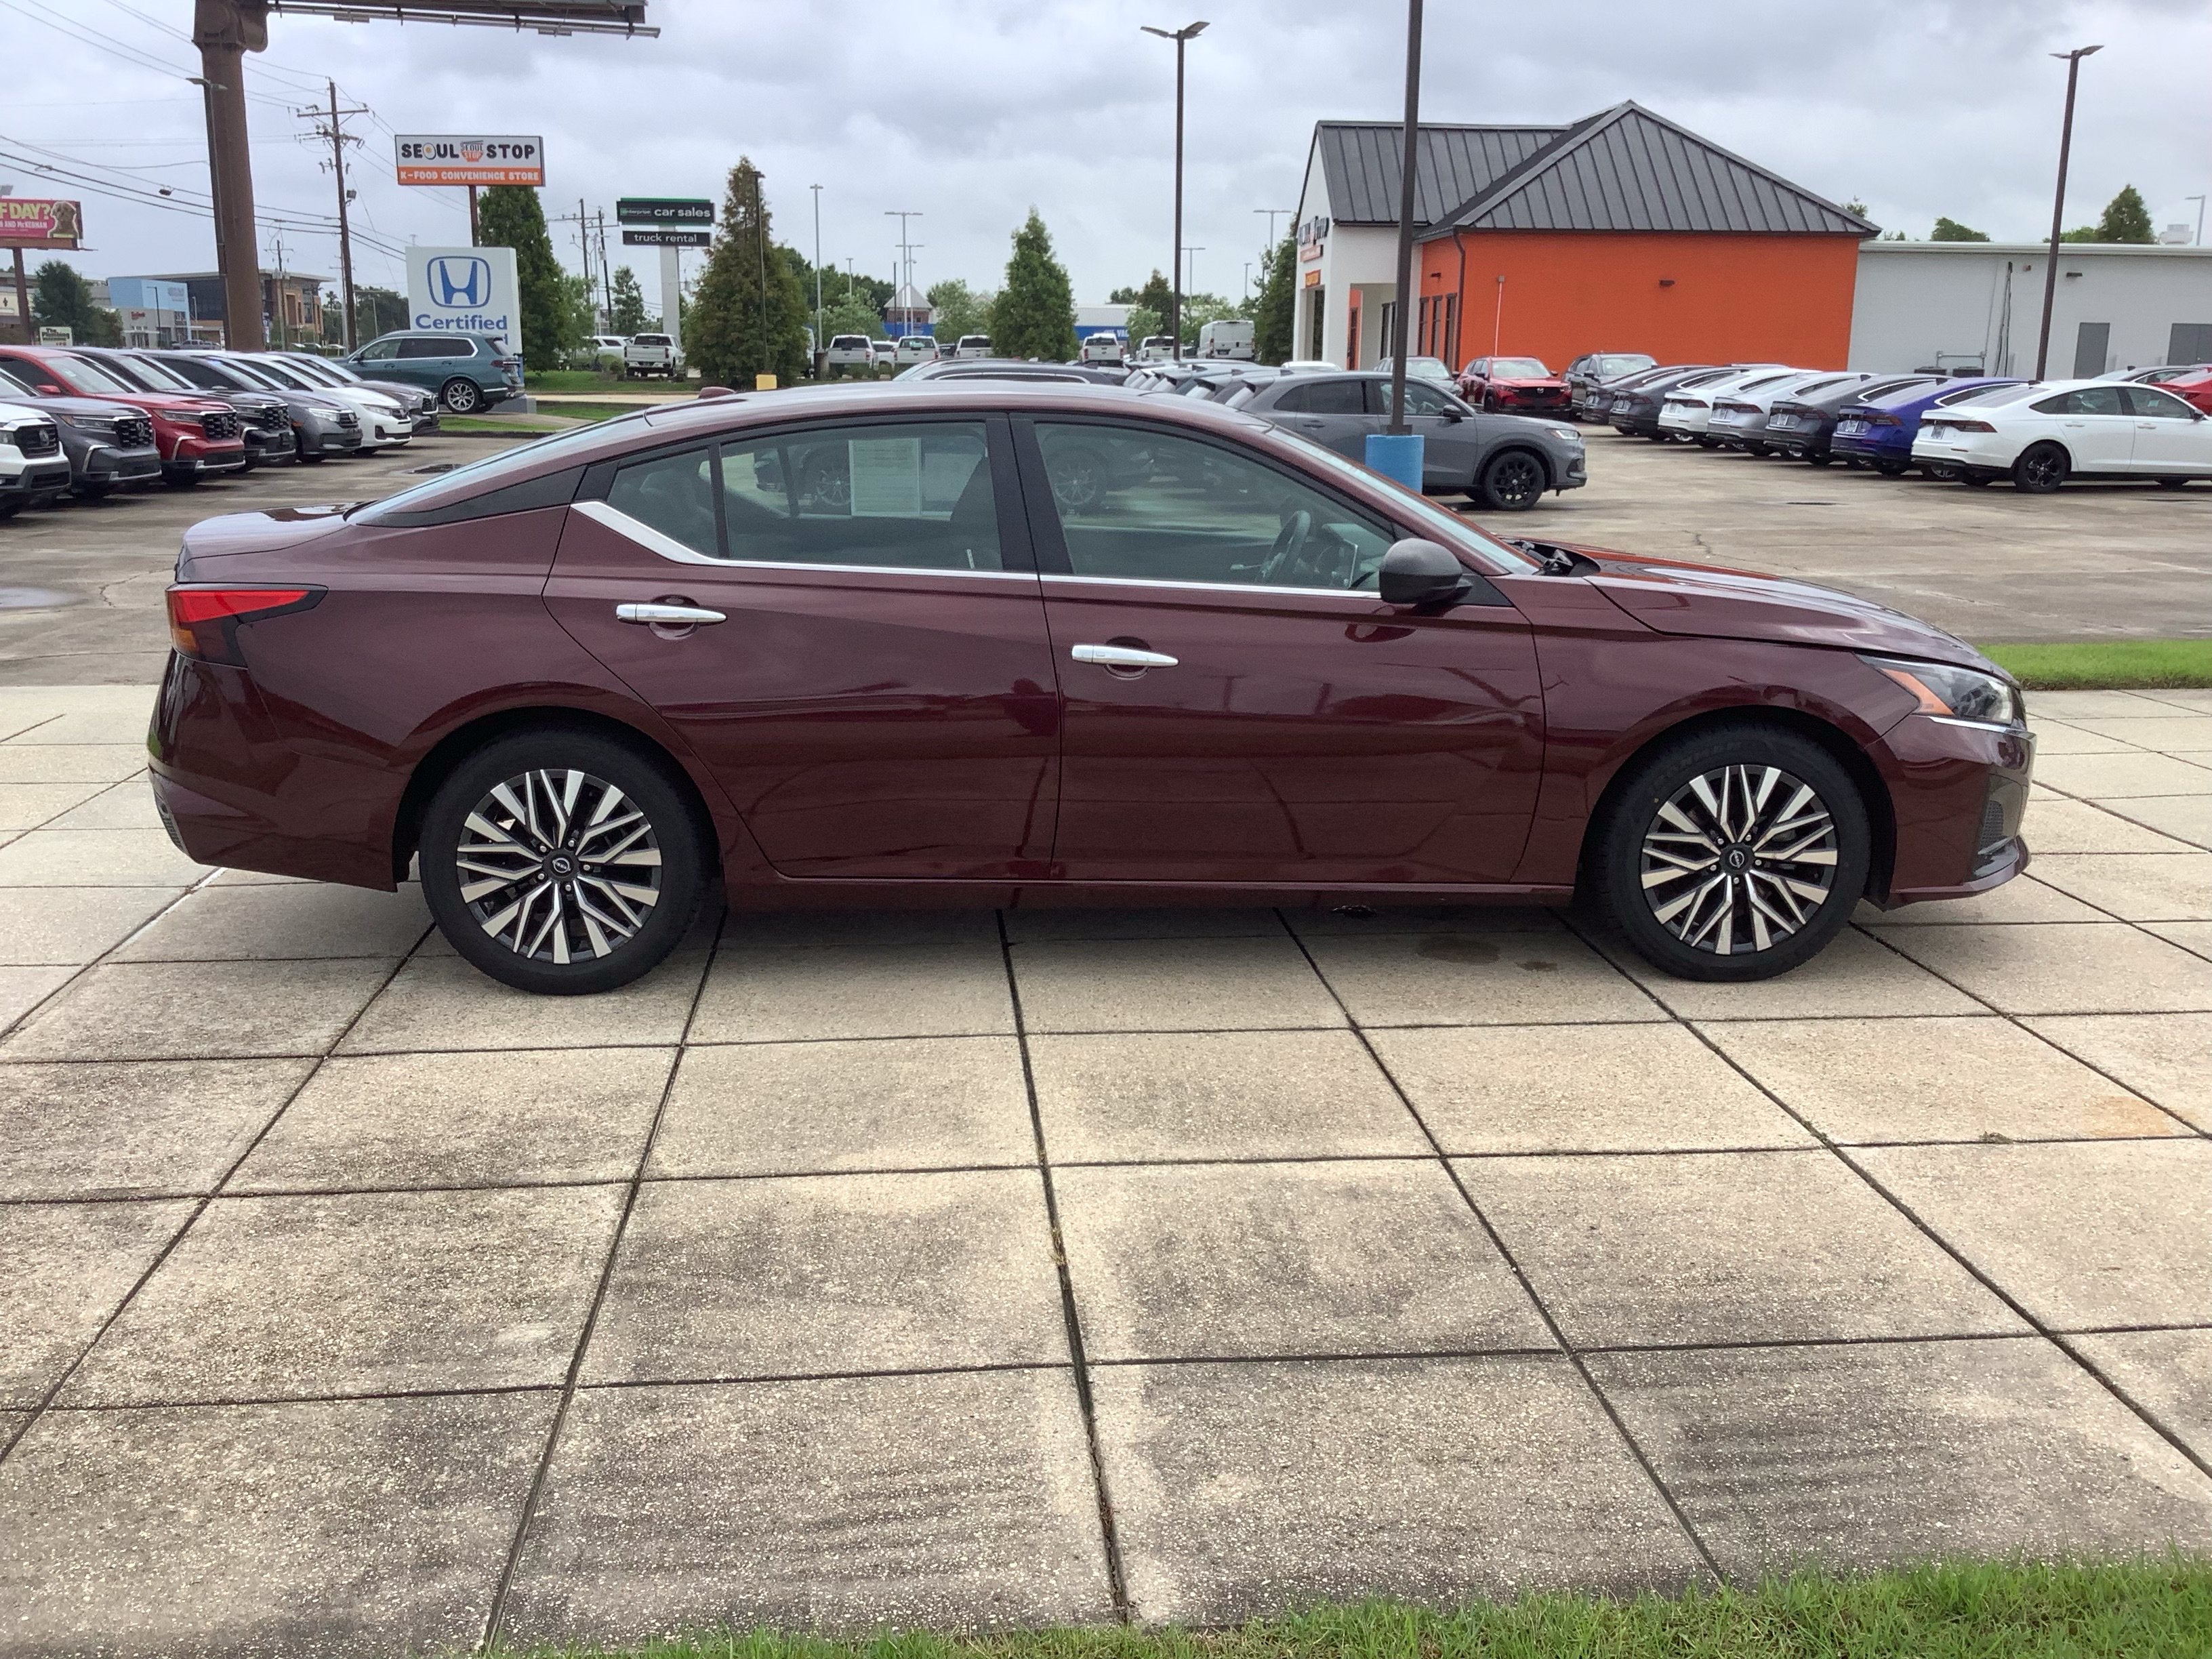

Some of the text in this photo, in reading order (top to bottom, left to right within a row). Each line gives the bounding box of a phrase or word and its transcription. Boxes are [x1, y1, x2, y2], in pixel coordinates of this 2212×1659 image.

[401, 143, 535, 160] SEOUL STOP
[401, 171, 539, 181] K-FOOD CONVENIENCE STORE
[9, 203, 52, 220] DAY?
[654, 208, 675, 217] car
[678, 207, 711, 218] sales
[634, 233, 697, 243] truck rental
[415, 314, 508, 330] Certified
